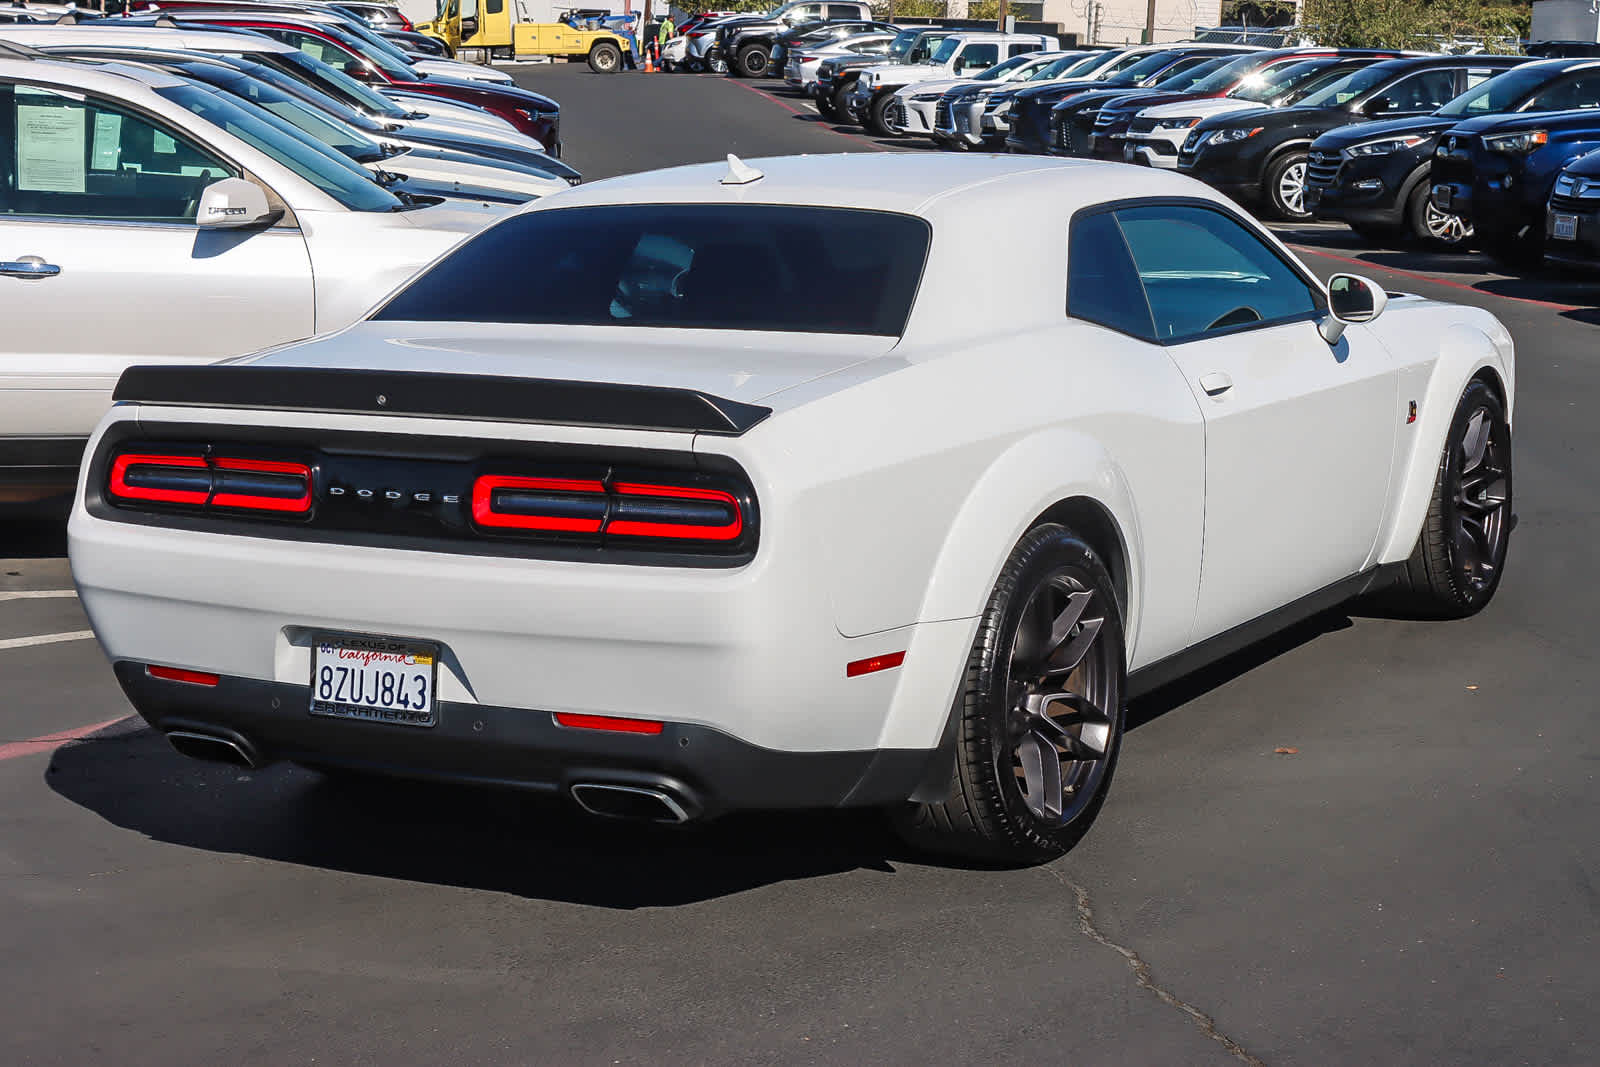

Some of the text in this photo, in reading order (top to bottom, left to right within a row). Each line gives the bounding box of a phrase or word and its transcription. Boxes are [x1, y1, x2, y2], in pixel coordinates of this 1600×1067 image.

[330, 487, 459, 503] DODGE
[343, 640, 407, 651] LEXUS OF
[338, 647, 416, 666] California
[319, 665, 427, 710] 8ZUJ843
